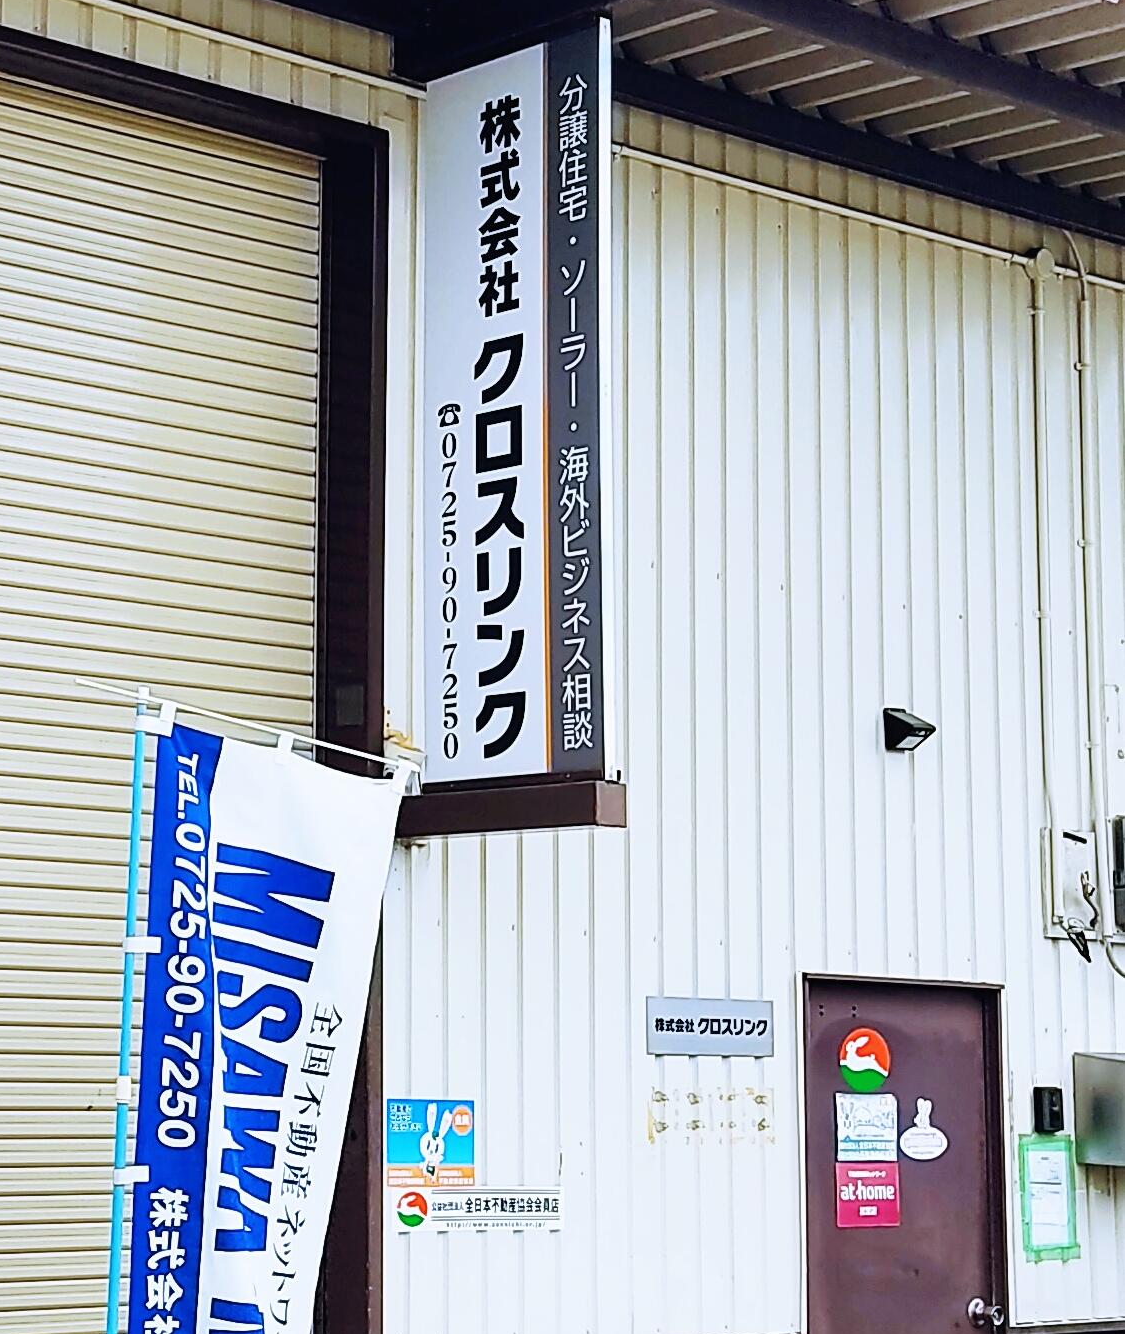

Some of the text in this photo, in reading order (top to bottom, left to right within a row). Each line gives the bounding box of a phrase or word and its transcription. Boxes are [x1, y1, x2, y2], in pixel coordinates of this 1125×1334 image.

[474, 93, 527, 759] 株式会社 クロスリンク
[558, 74, 594, 750] 分譲住宅・ソーラー・海外ビジネス相談
[440, 433, 460, 761] 0725-90-7250
[157, 753, 207, 1149] TEL.0725-90-7250
[654, 1017, 769, 1037] 株式会社 クロスリンク
[856, 1179, 896, 1201] home
